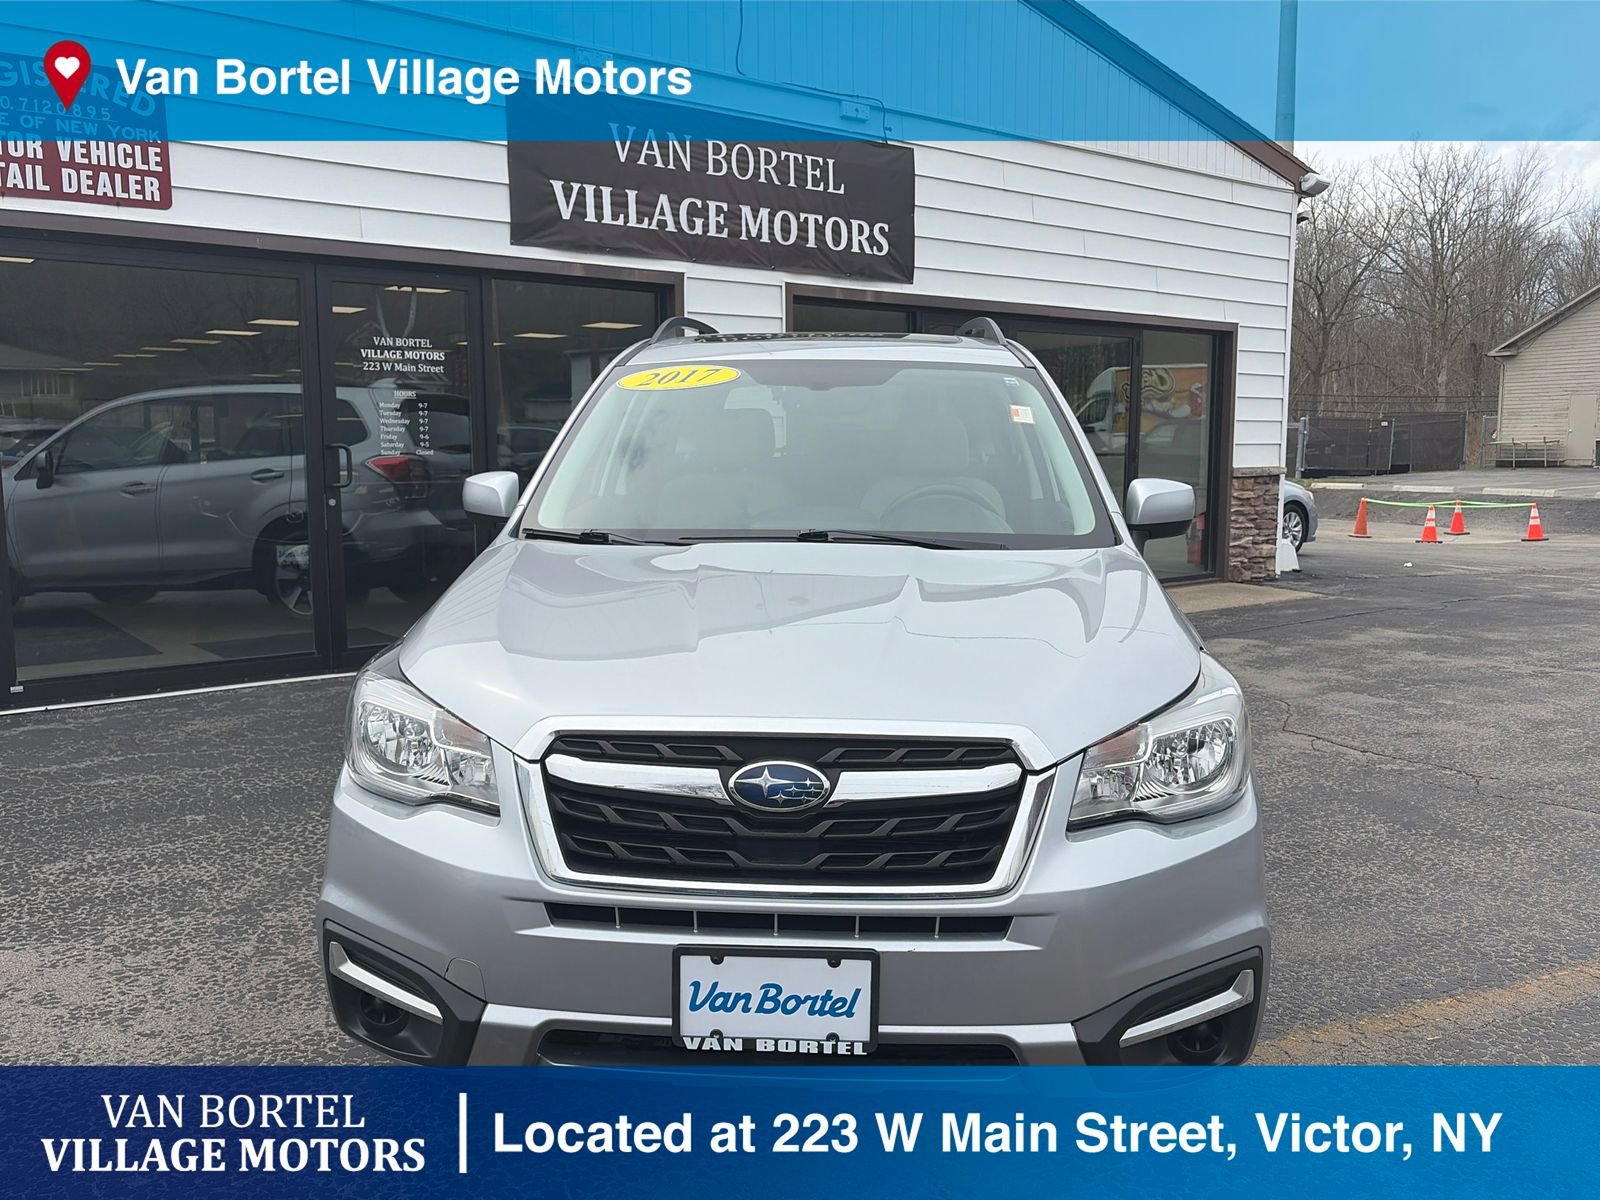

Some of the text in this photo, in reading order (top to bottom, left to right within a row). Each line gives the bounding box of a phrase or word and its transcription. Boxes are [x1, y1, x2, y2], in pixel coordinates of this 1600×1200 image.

[20, 115, 46, 129] OF
[56, 118, 98, 136] NEW
[107, 124, 161, 144] YORK
[55, 136, 163, 173] VEHICLE
[608, 122, 845, 195] VAN BORTEL
[61, 167, 161, 202] DEALER
[549, 179, 890, 257] VILLAGE MOTORS
[373, 336, 432, 348] VAN BORTEL
[360, 349, 445, 361] VILLAGE MOTORS
[363, 361, 444, 374] 223 W Main Street
[636, 368, 722, 387] 2017
[394, 390, 417, 398] HOURS
[689, 980, 862, 1018] Van Bortel
[682, 1035, 868, 1056] VAN BORTEL
